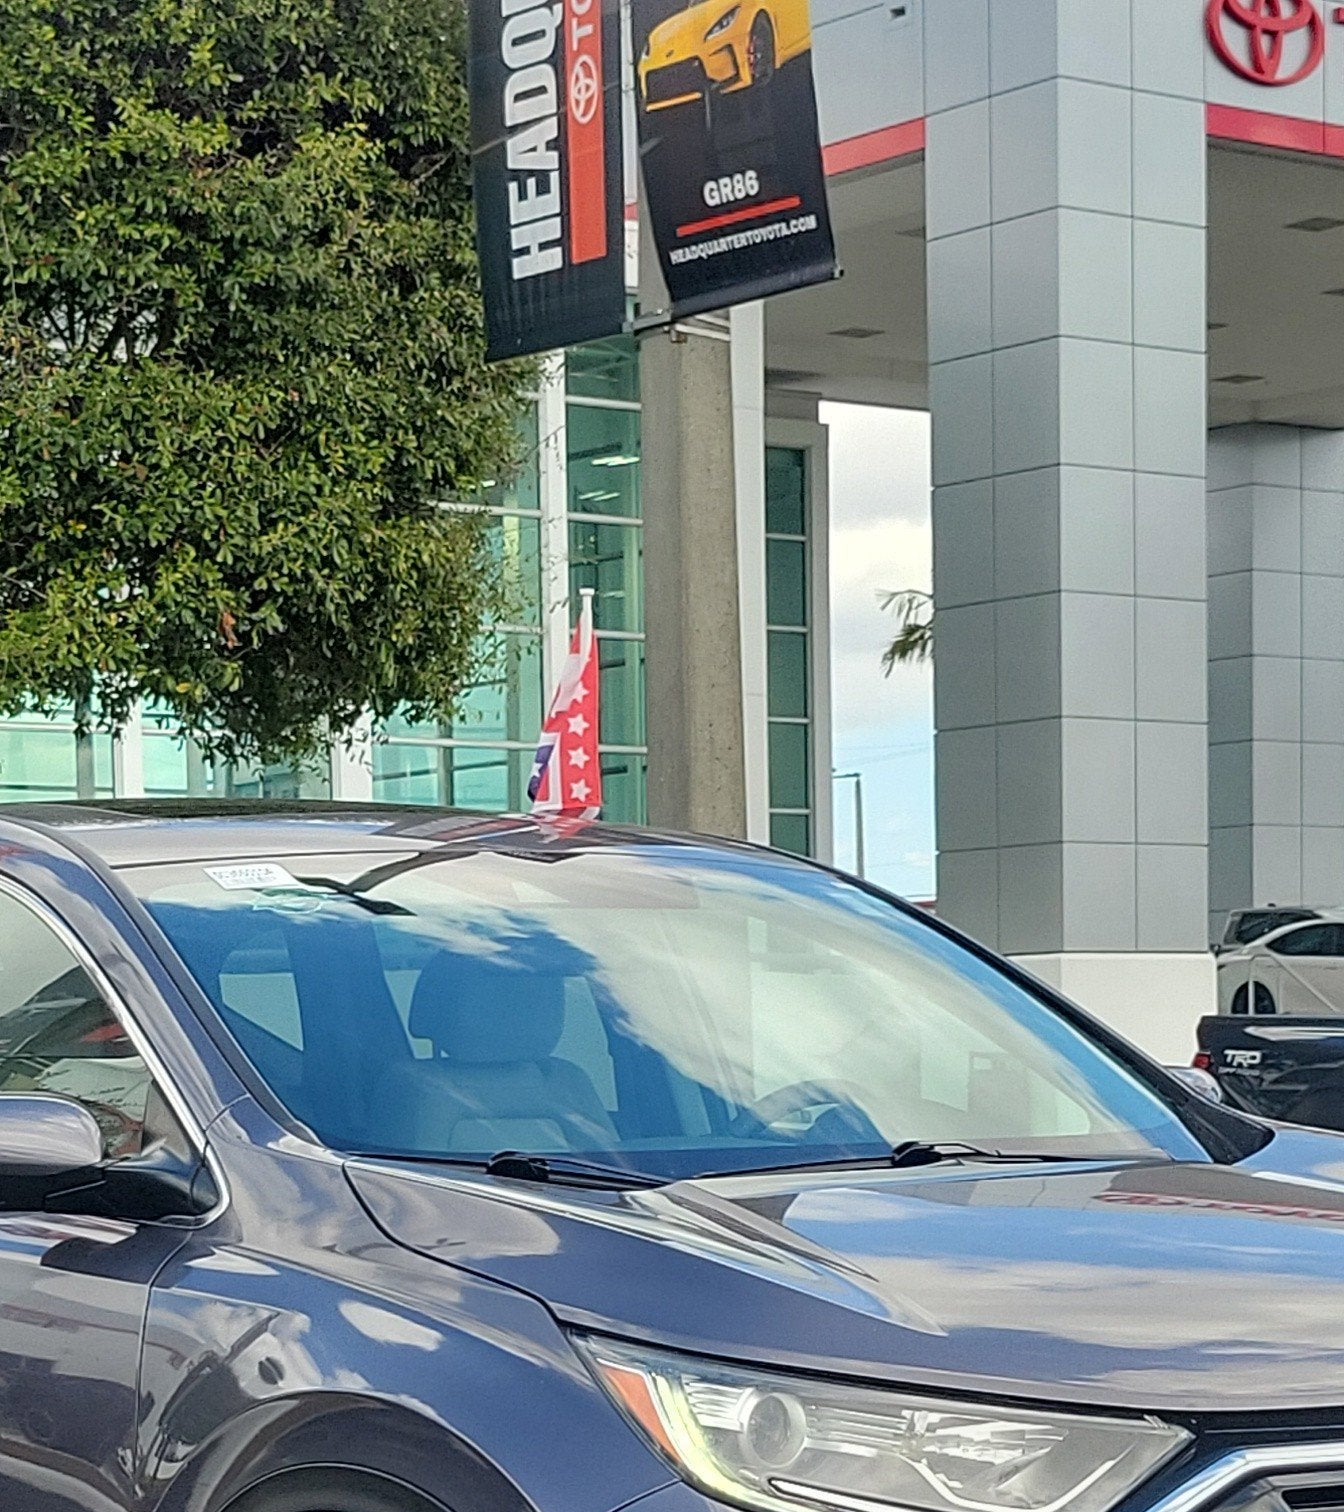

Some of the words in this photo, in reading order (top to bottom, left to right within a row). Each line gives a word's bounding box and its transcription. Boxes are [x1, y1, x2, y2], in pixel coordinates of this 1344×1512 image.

[703, 170, 760, 207] GR86
[669, 214, 818, 265] HEADQUARTERTOYOTA.COM
[1223, 1049, 1262, 1067] TRD
